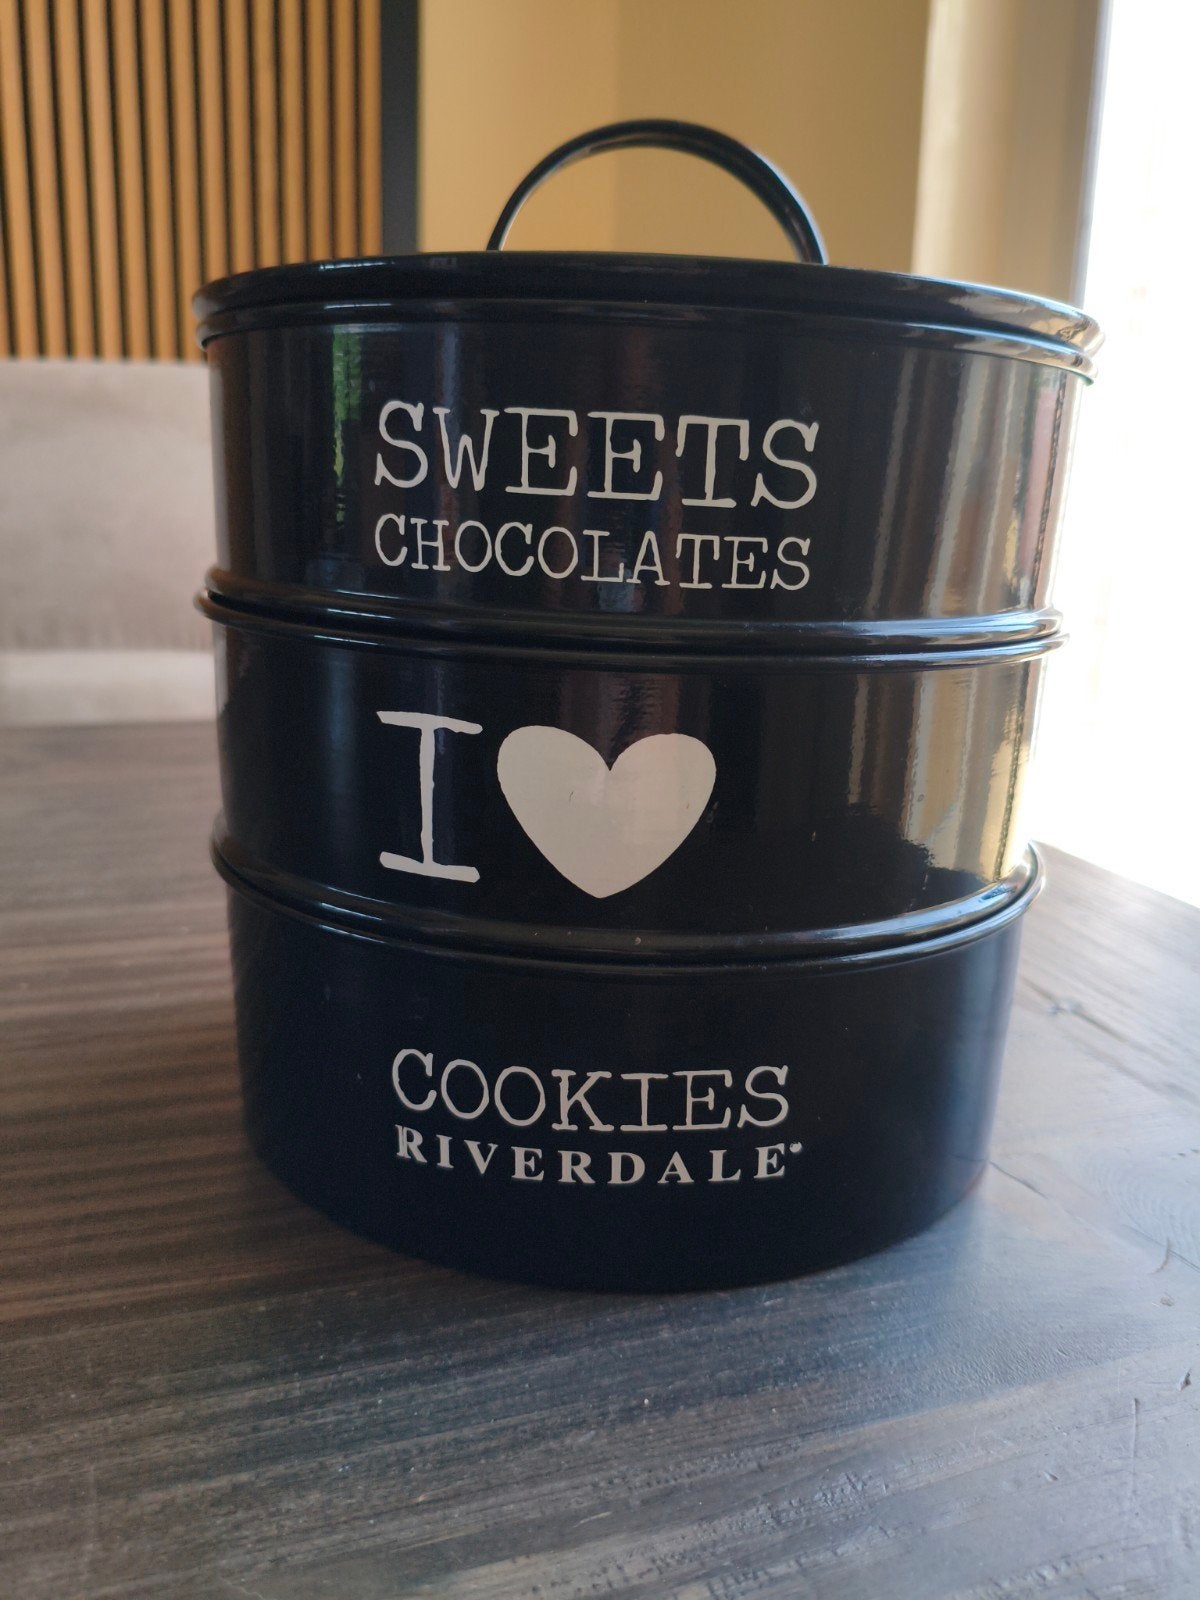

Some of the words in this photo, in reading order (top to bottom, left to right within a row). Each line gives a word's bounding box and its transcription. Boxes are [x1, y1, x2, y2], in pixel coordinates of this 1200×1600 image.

[374, 399, 820, 510] SWEETS
[374, 512, 811, 592] CHOCOLATES
[376, 710, 483, 883] I
[391, 1048, 790, 1133] COOKIES
